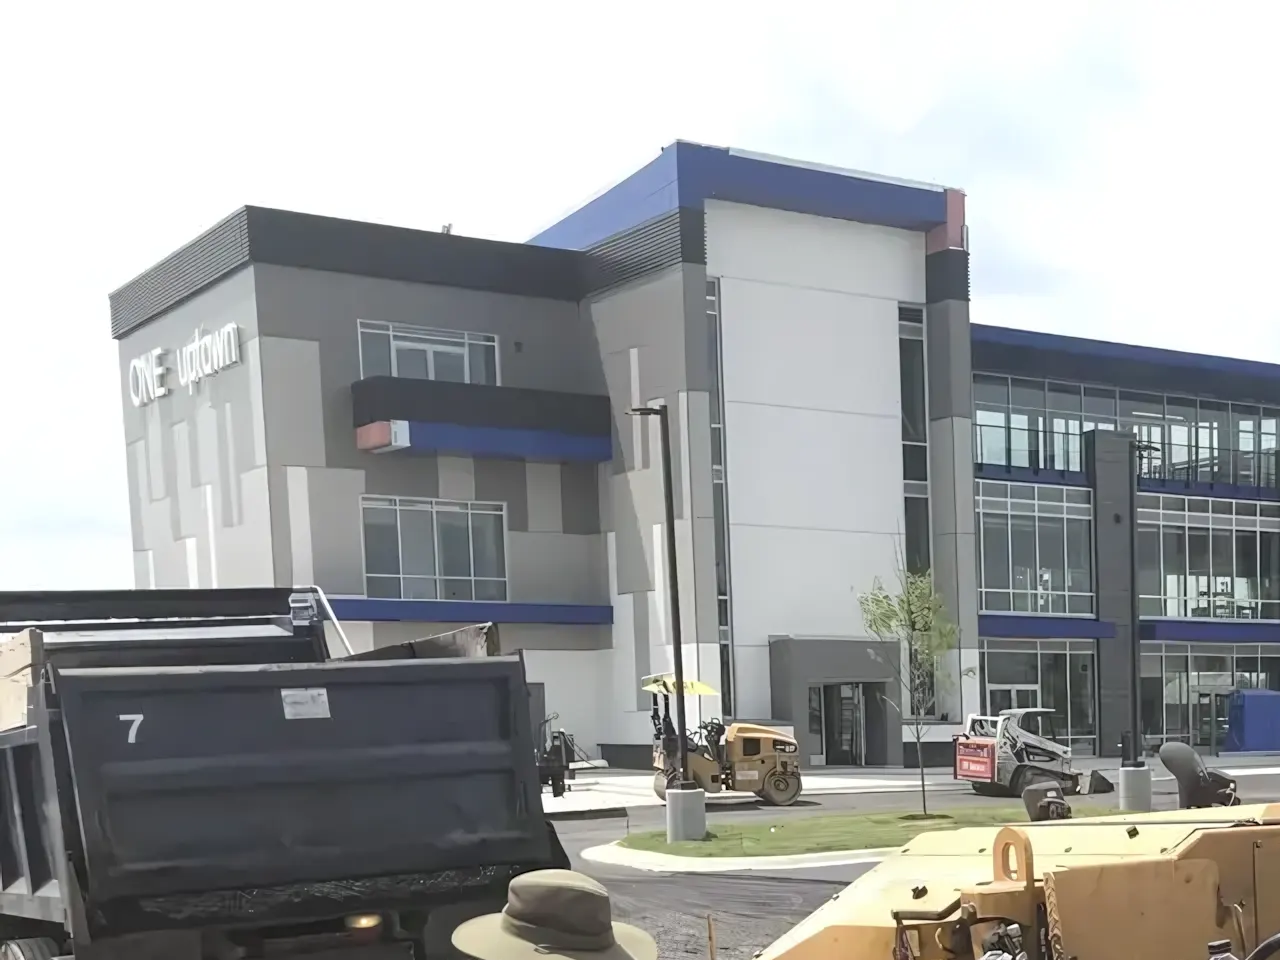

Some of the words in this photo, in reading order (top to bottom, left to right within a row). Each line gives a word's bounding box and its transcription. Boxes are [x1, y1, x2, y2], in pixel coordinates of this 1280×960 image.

[129, 347, 168, 407] ONE
[176, 321, 240, 395] uptown
[119, 714, 144, 743] 7
